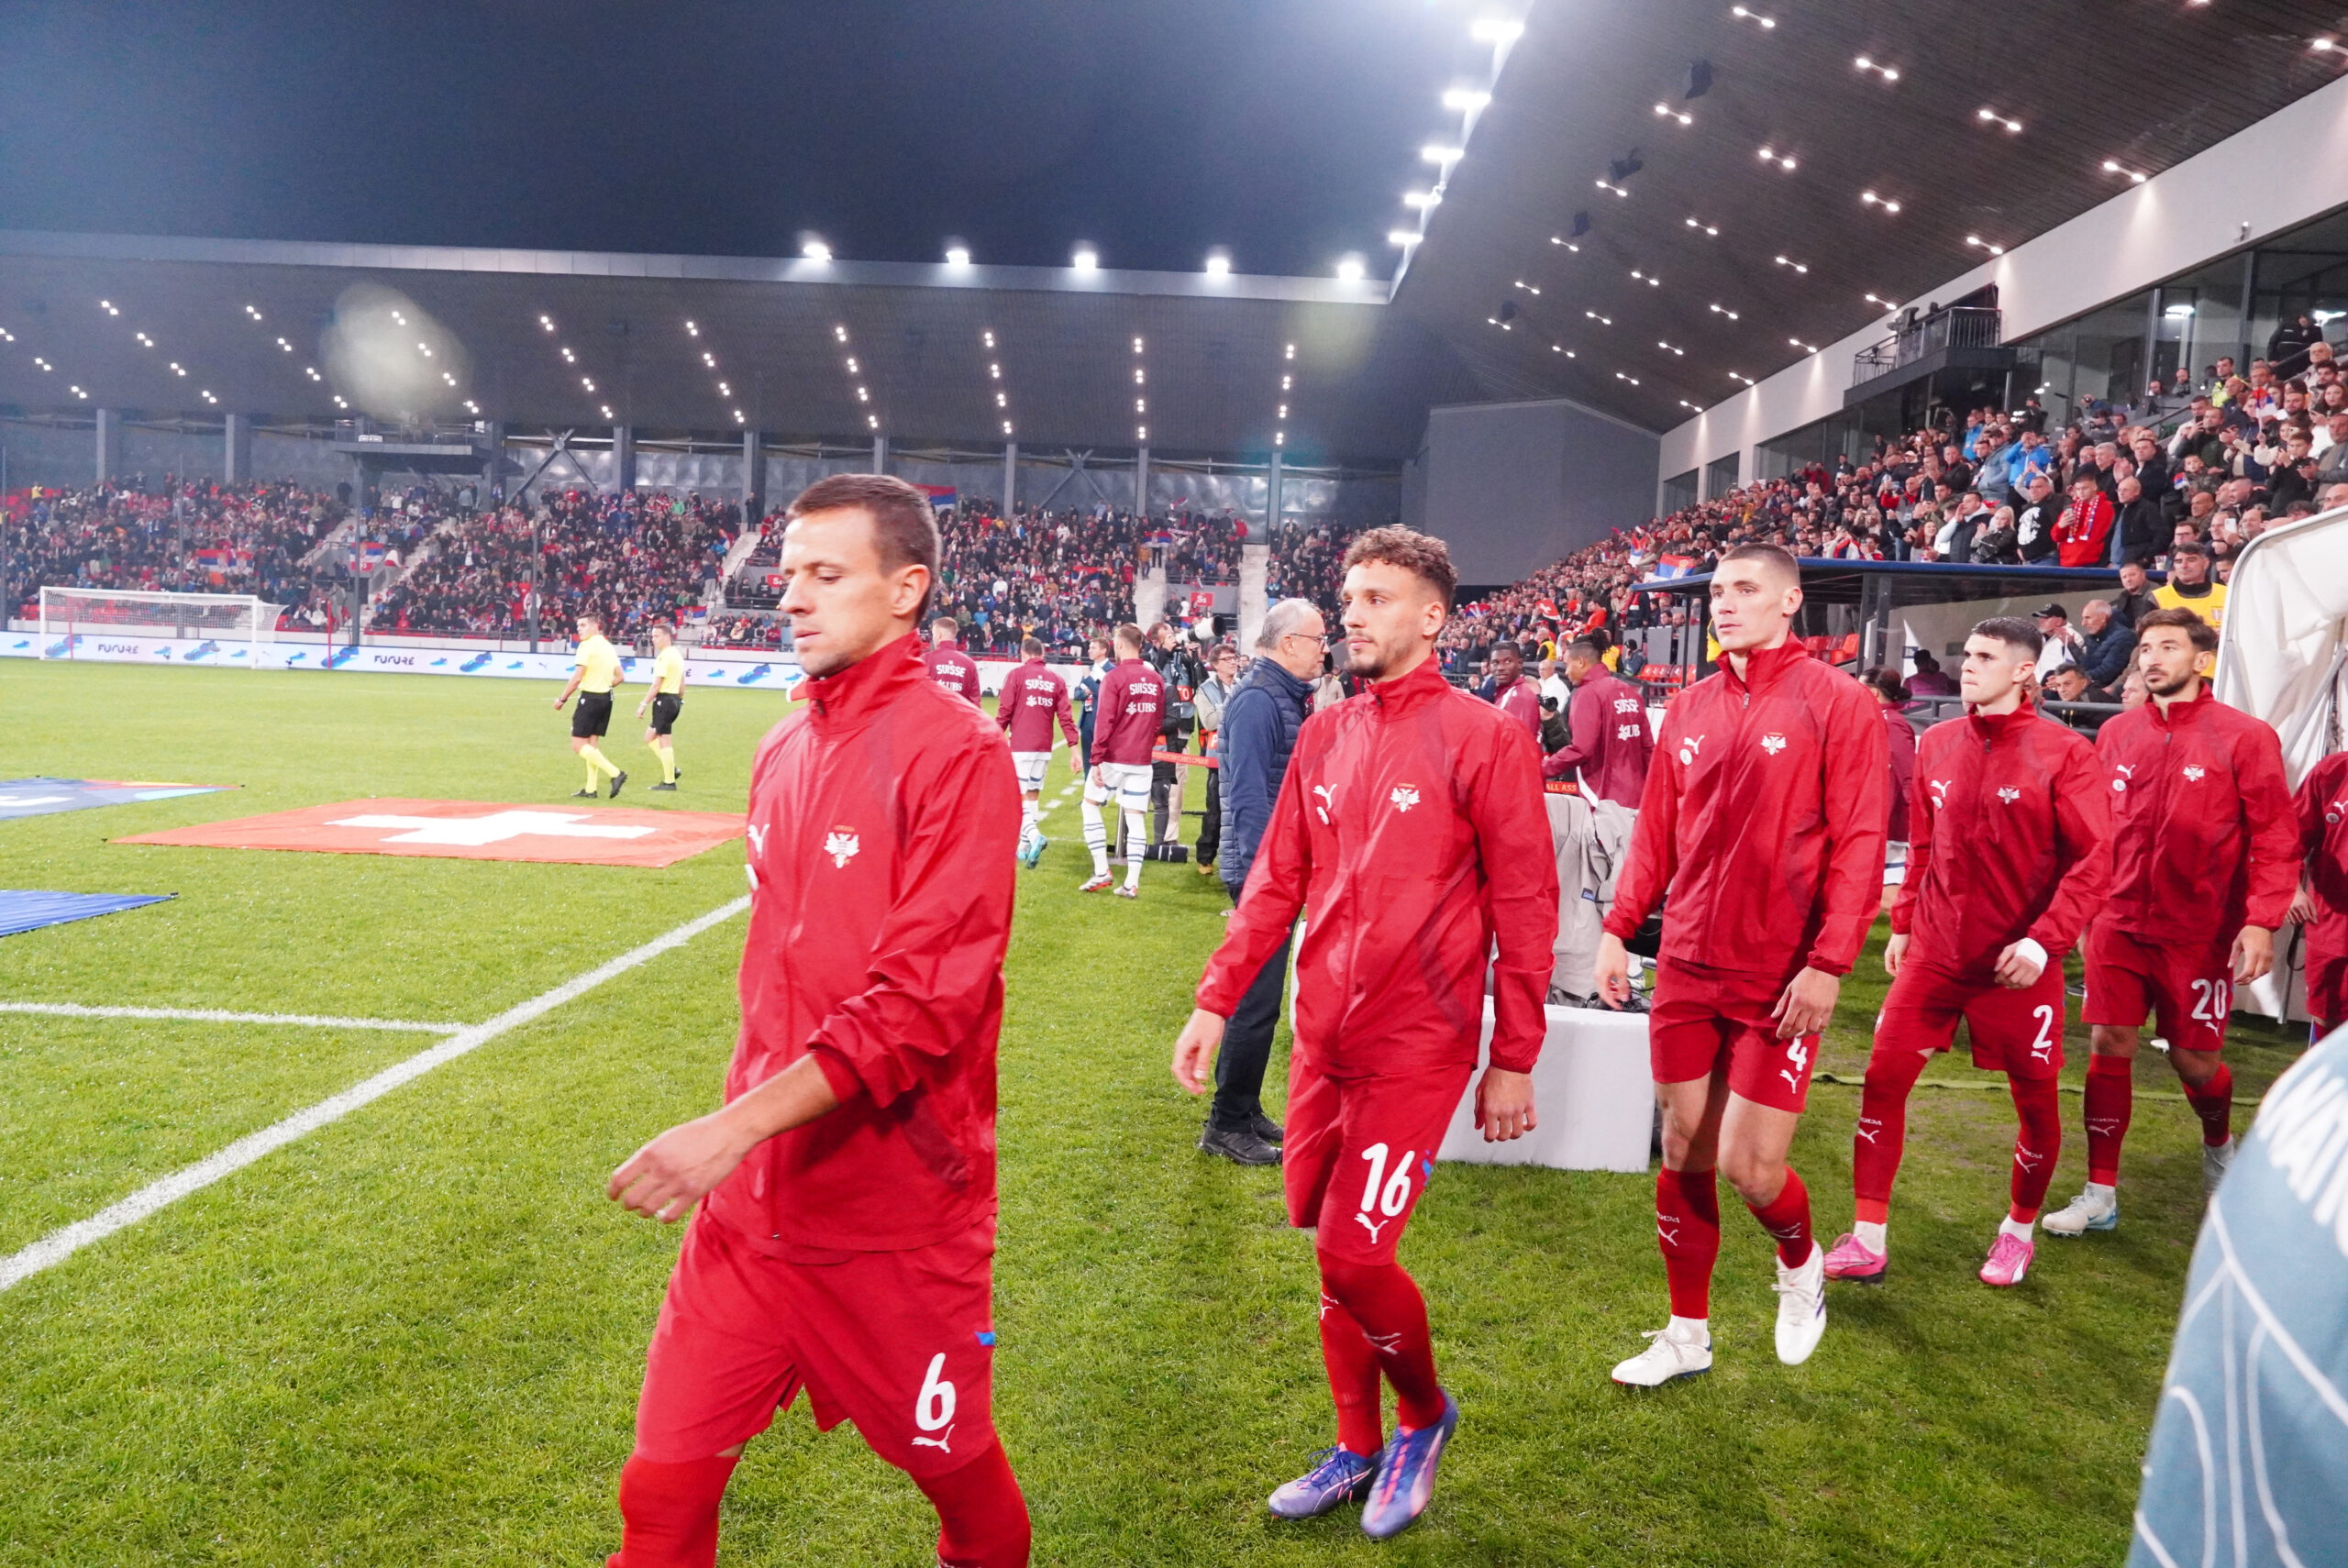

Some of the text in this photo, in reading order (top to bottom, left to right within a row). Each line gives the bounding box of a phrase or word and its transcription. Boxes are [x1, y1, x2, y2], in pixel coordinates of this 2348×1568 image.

[98, 644, 139, 654] FUTURE
[374, 655, 415, 666] FUTURE
[936, 664, 967, 678] SUISSE
[1024, 679, 1056, 692] SUISSE
[1129, 682, 1158, 696] SUISSE
[1037, 696, 1054, 707] UBS
[1136, 702, 1157, 712] UBS
[2191, 978, 2227, 1020] 20
[2032, 1004, 2053, 1049] 2
[1787, 1037, 1807, 1072] 4
[1360, 1143, 1415, 1217] 16
[915, 1353, 956, 1430] 6
